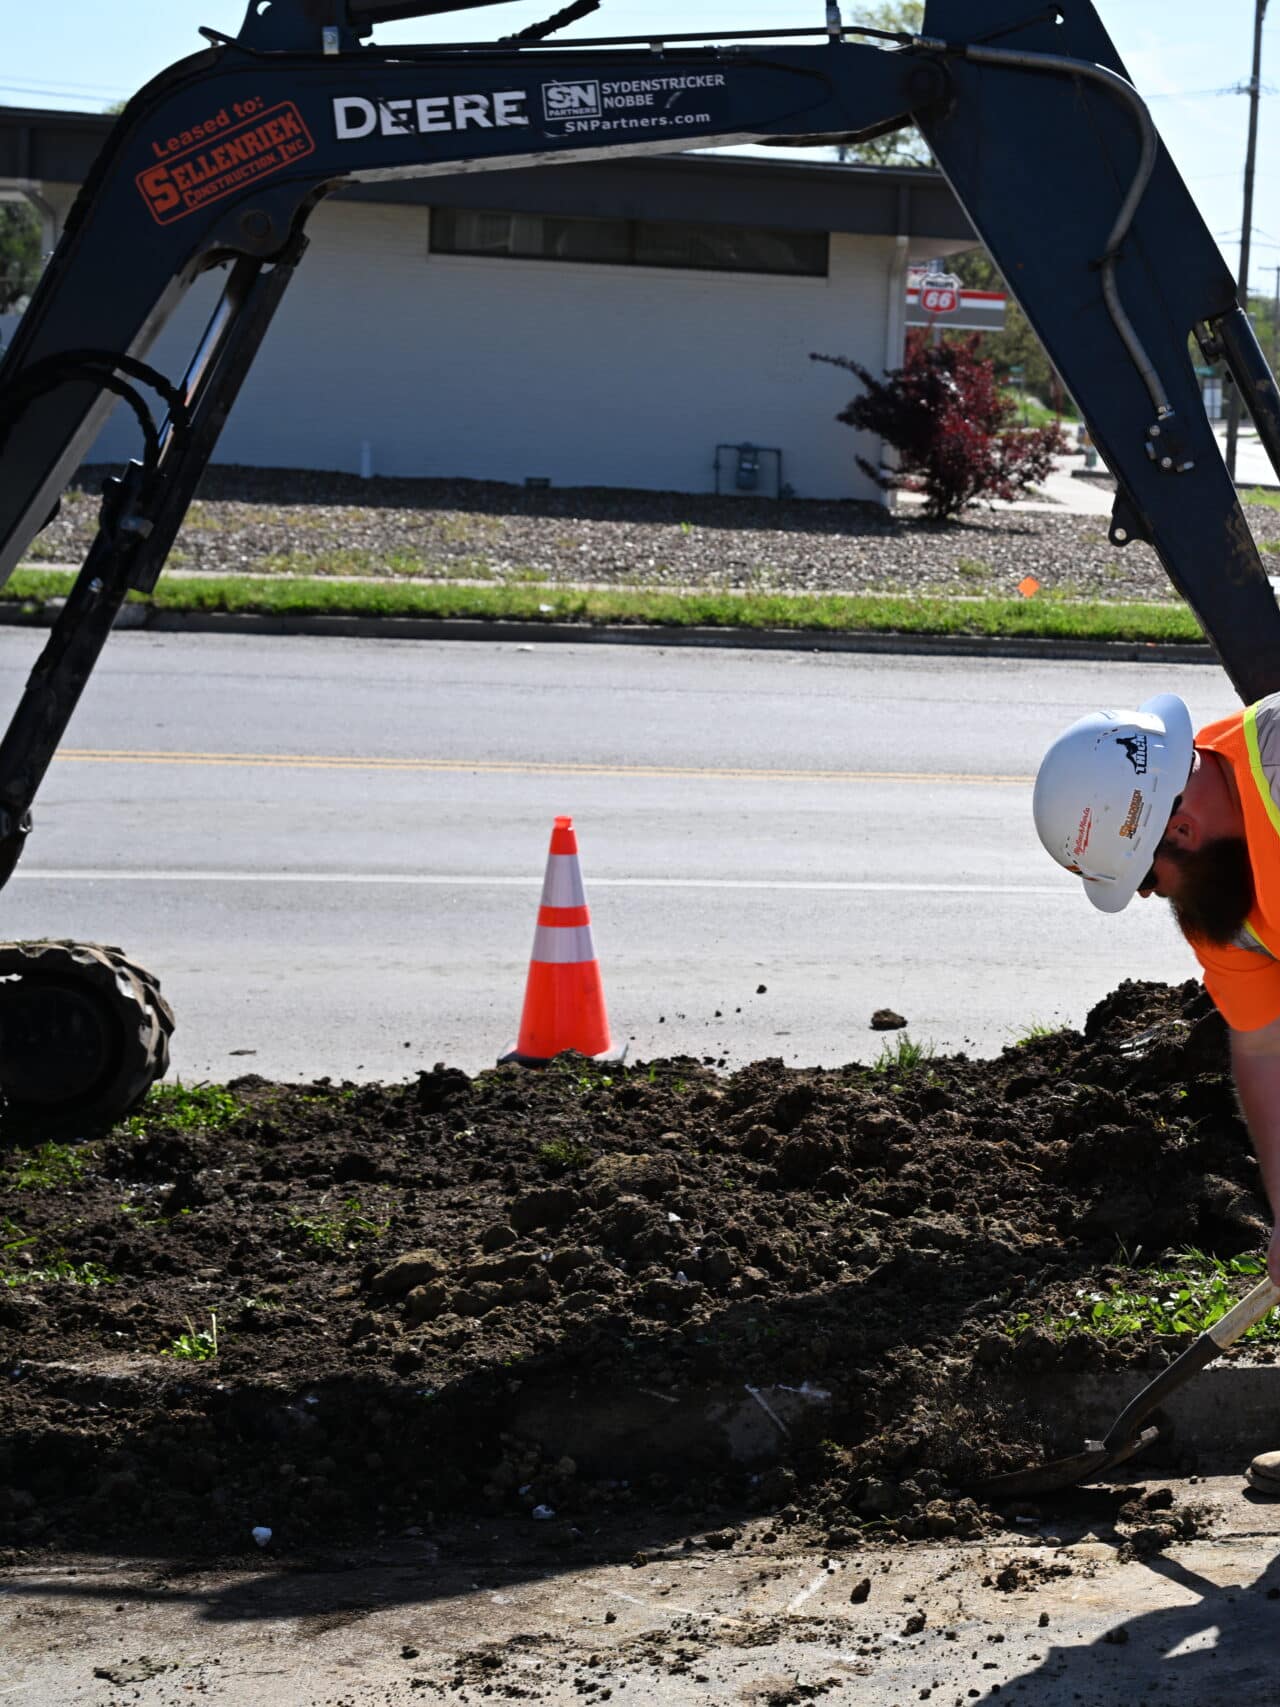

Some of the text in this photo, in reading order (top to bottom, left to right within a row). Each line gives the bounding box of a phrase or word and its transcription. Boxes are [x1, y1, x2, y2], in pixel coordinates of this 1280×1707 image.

[601, 74, 725, 95] SYDENSTRICKER
[547, 84, 597, 109] SN
[603, 93, 655, 109] NOBBE
[333, 91, 529, 139] DEERE
[549, 107, 598, 117] PARTNERS
[564, 113, 711, 133] SNPartners.com
[151, 95, 264, 158] Leased to:
[142, 111, 302, 213] SELLENRIEK
[182, 138, 306, 209] CONSTRUCTION INC
[926, 291, 952, 308] 66
